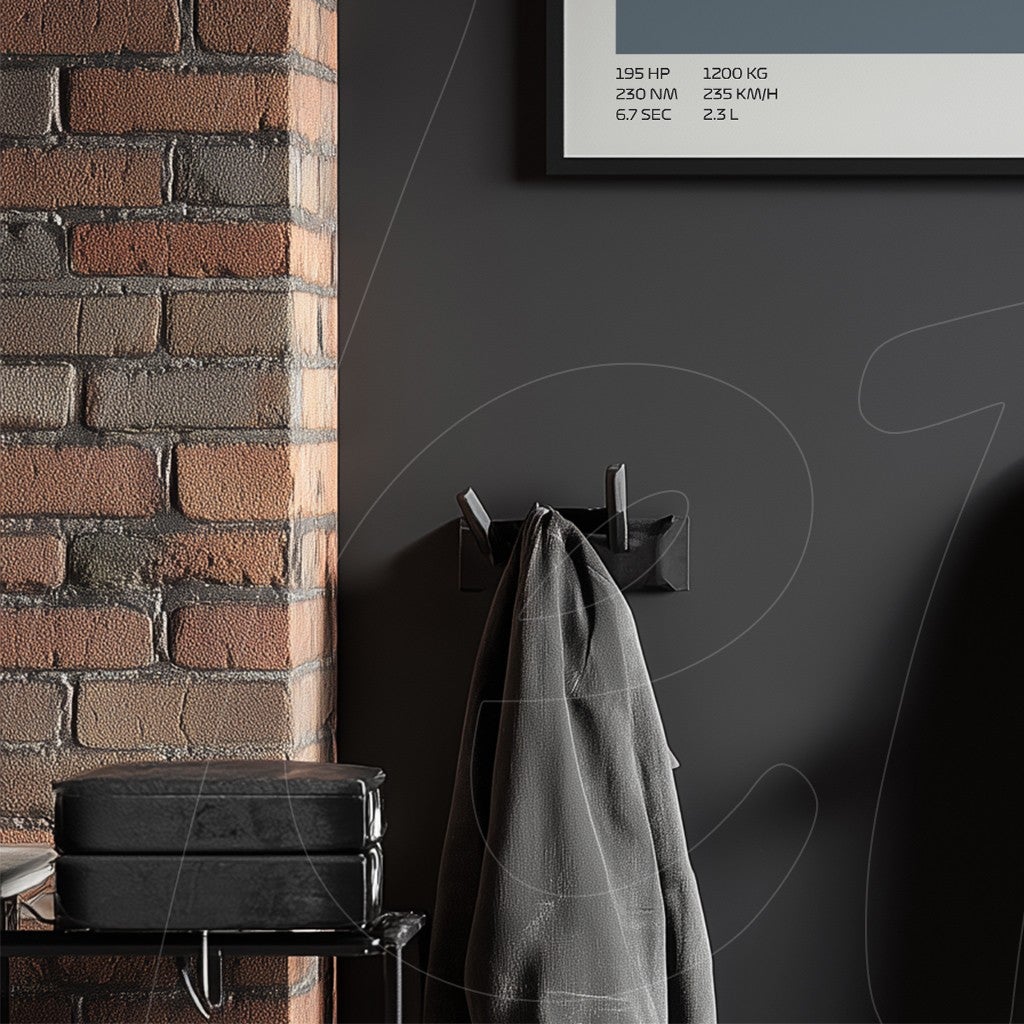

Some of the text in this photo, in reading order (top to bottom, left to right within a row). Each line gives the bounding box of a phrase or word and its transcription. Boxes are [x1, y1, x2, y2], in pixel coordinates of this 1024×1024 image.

[615, 67, 671, 80] 195 HP
[703, 67, 768, 80] 1200 KG
[615, 87, 679, 100] 230 NM
[703, 87, 778, 102] 235 KM/H
[615, 108, 672, 121] 6.7 SEC
[703, 108, 739, 121] 2.3 L
